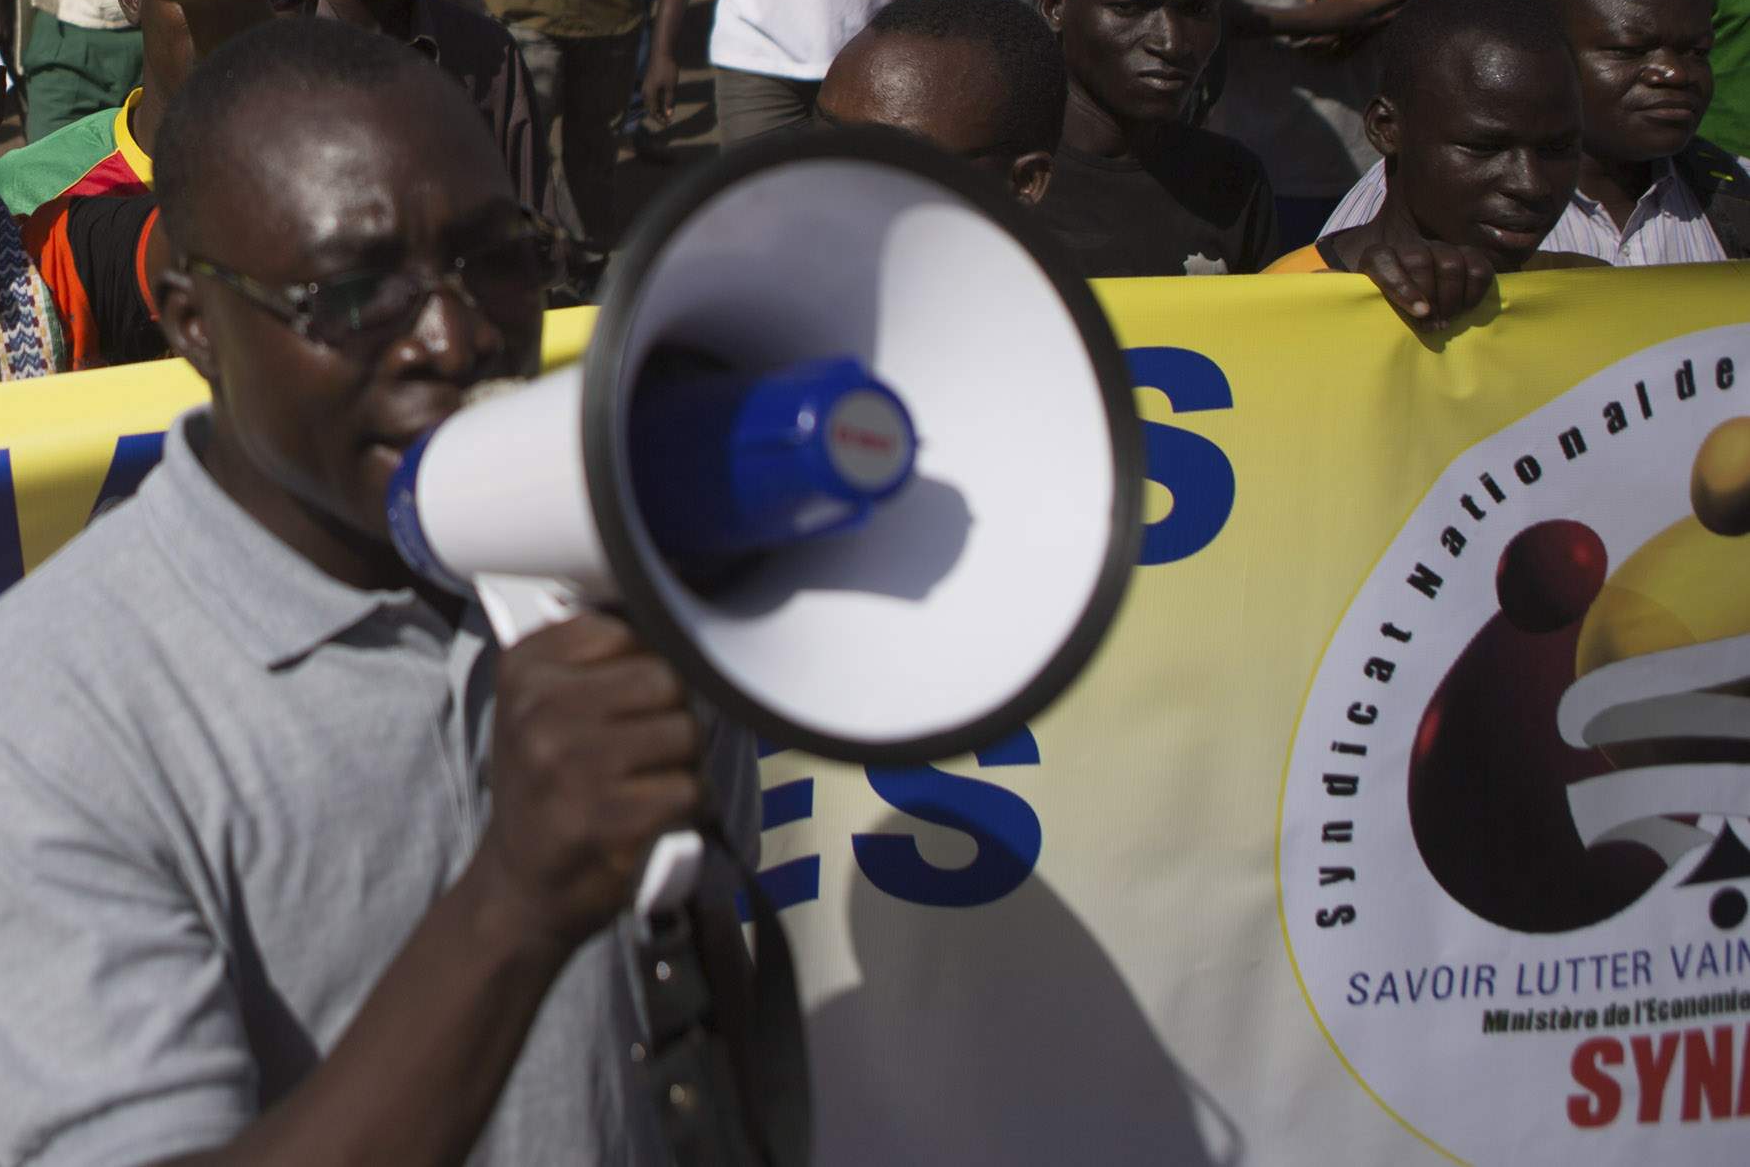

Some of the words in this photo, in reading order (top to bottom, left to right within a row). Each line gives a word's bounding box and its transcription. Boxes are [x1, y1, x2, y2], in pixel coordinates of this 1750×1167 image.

[1316, 623, 1412, 928] Syndicat
[1346, 964, 1496, 1005] SAVOIR
[1516, 950, 1652, 997] LUTTER
[1483, 1006, 1599, 1034] Ministère
[1603, 1002, 1631, 1027] de
